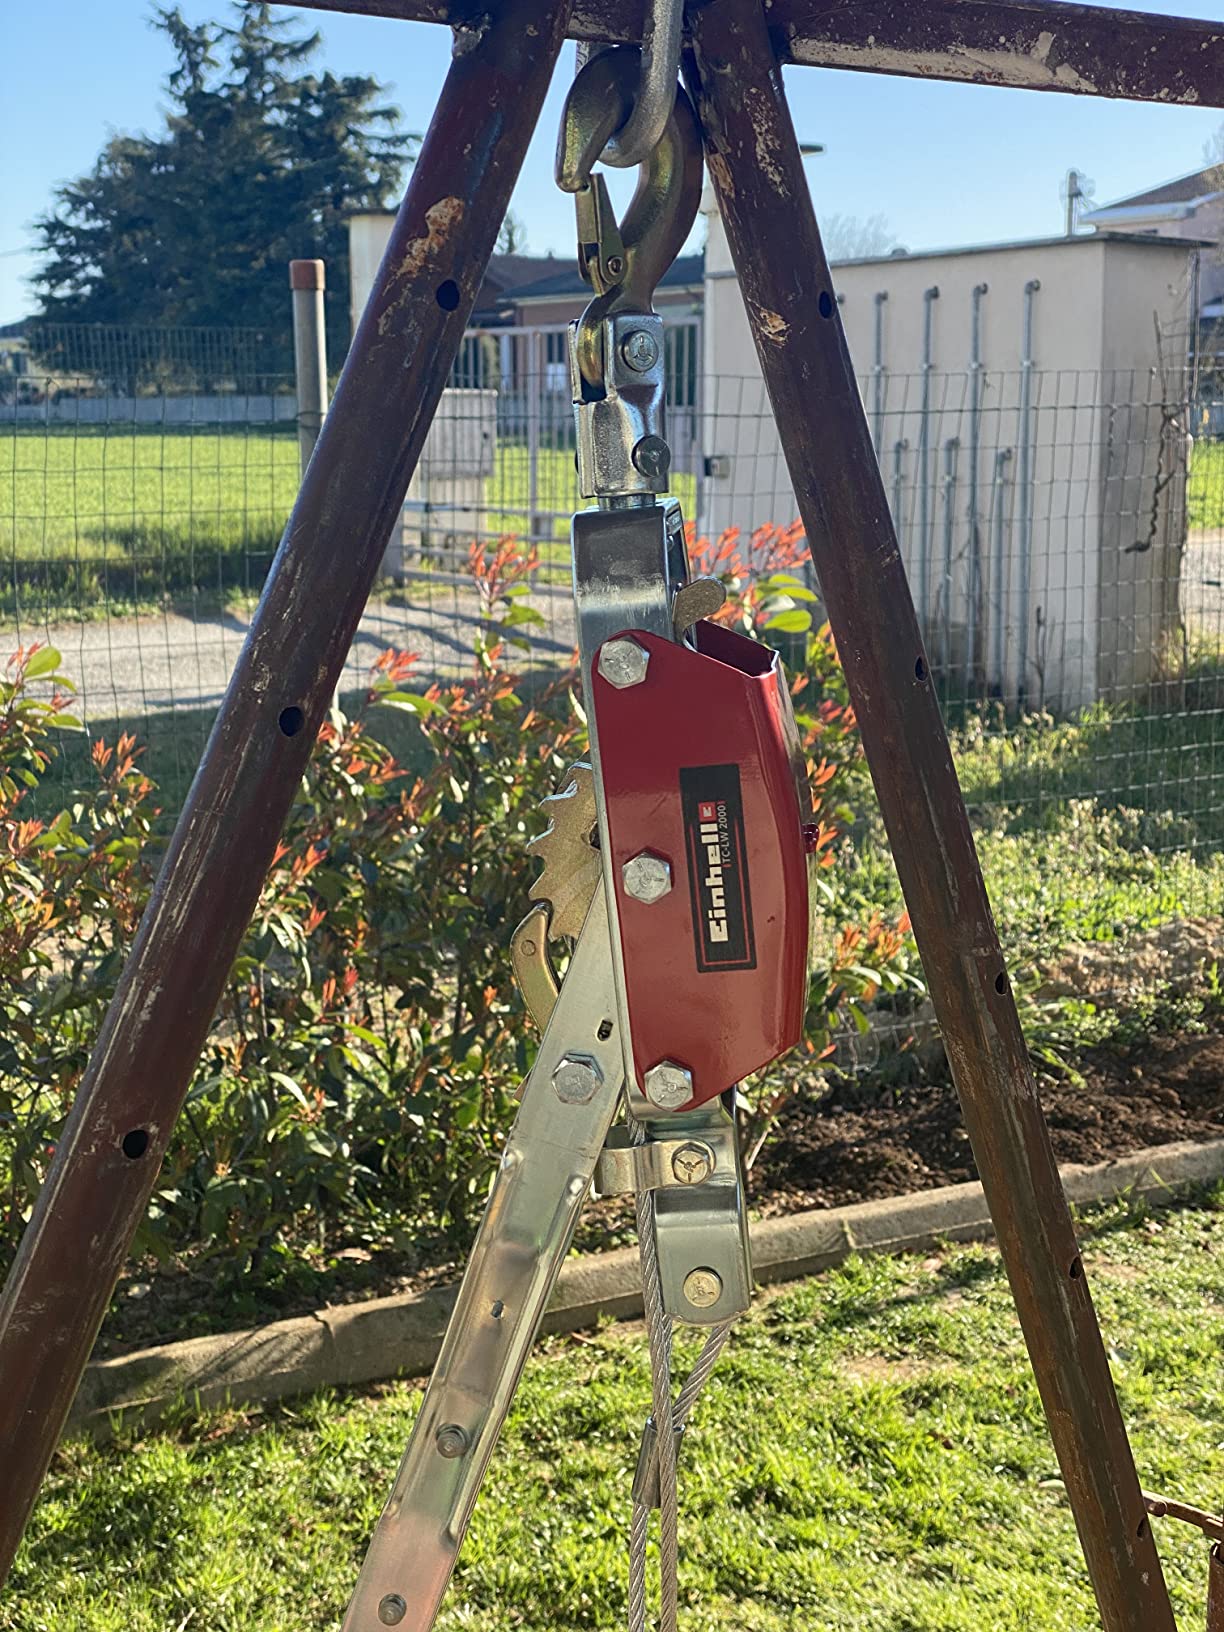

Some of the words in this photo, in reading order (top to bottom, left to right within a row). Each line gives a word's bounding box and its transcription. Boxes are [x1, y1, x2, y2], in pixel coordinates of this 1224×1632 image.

[717, 805, 728, 829] 2000
[720, 831, 731, 863] TC-LW
[700, 824, 728, 942] Einhell
